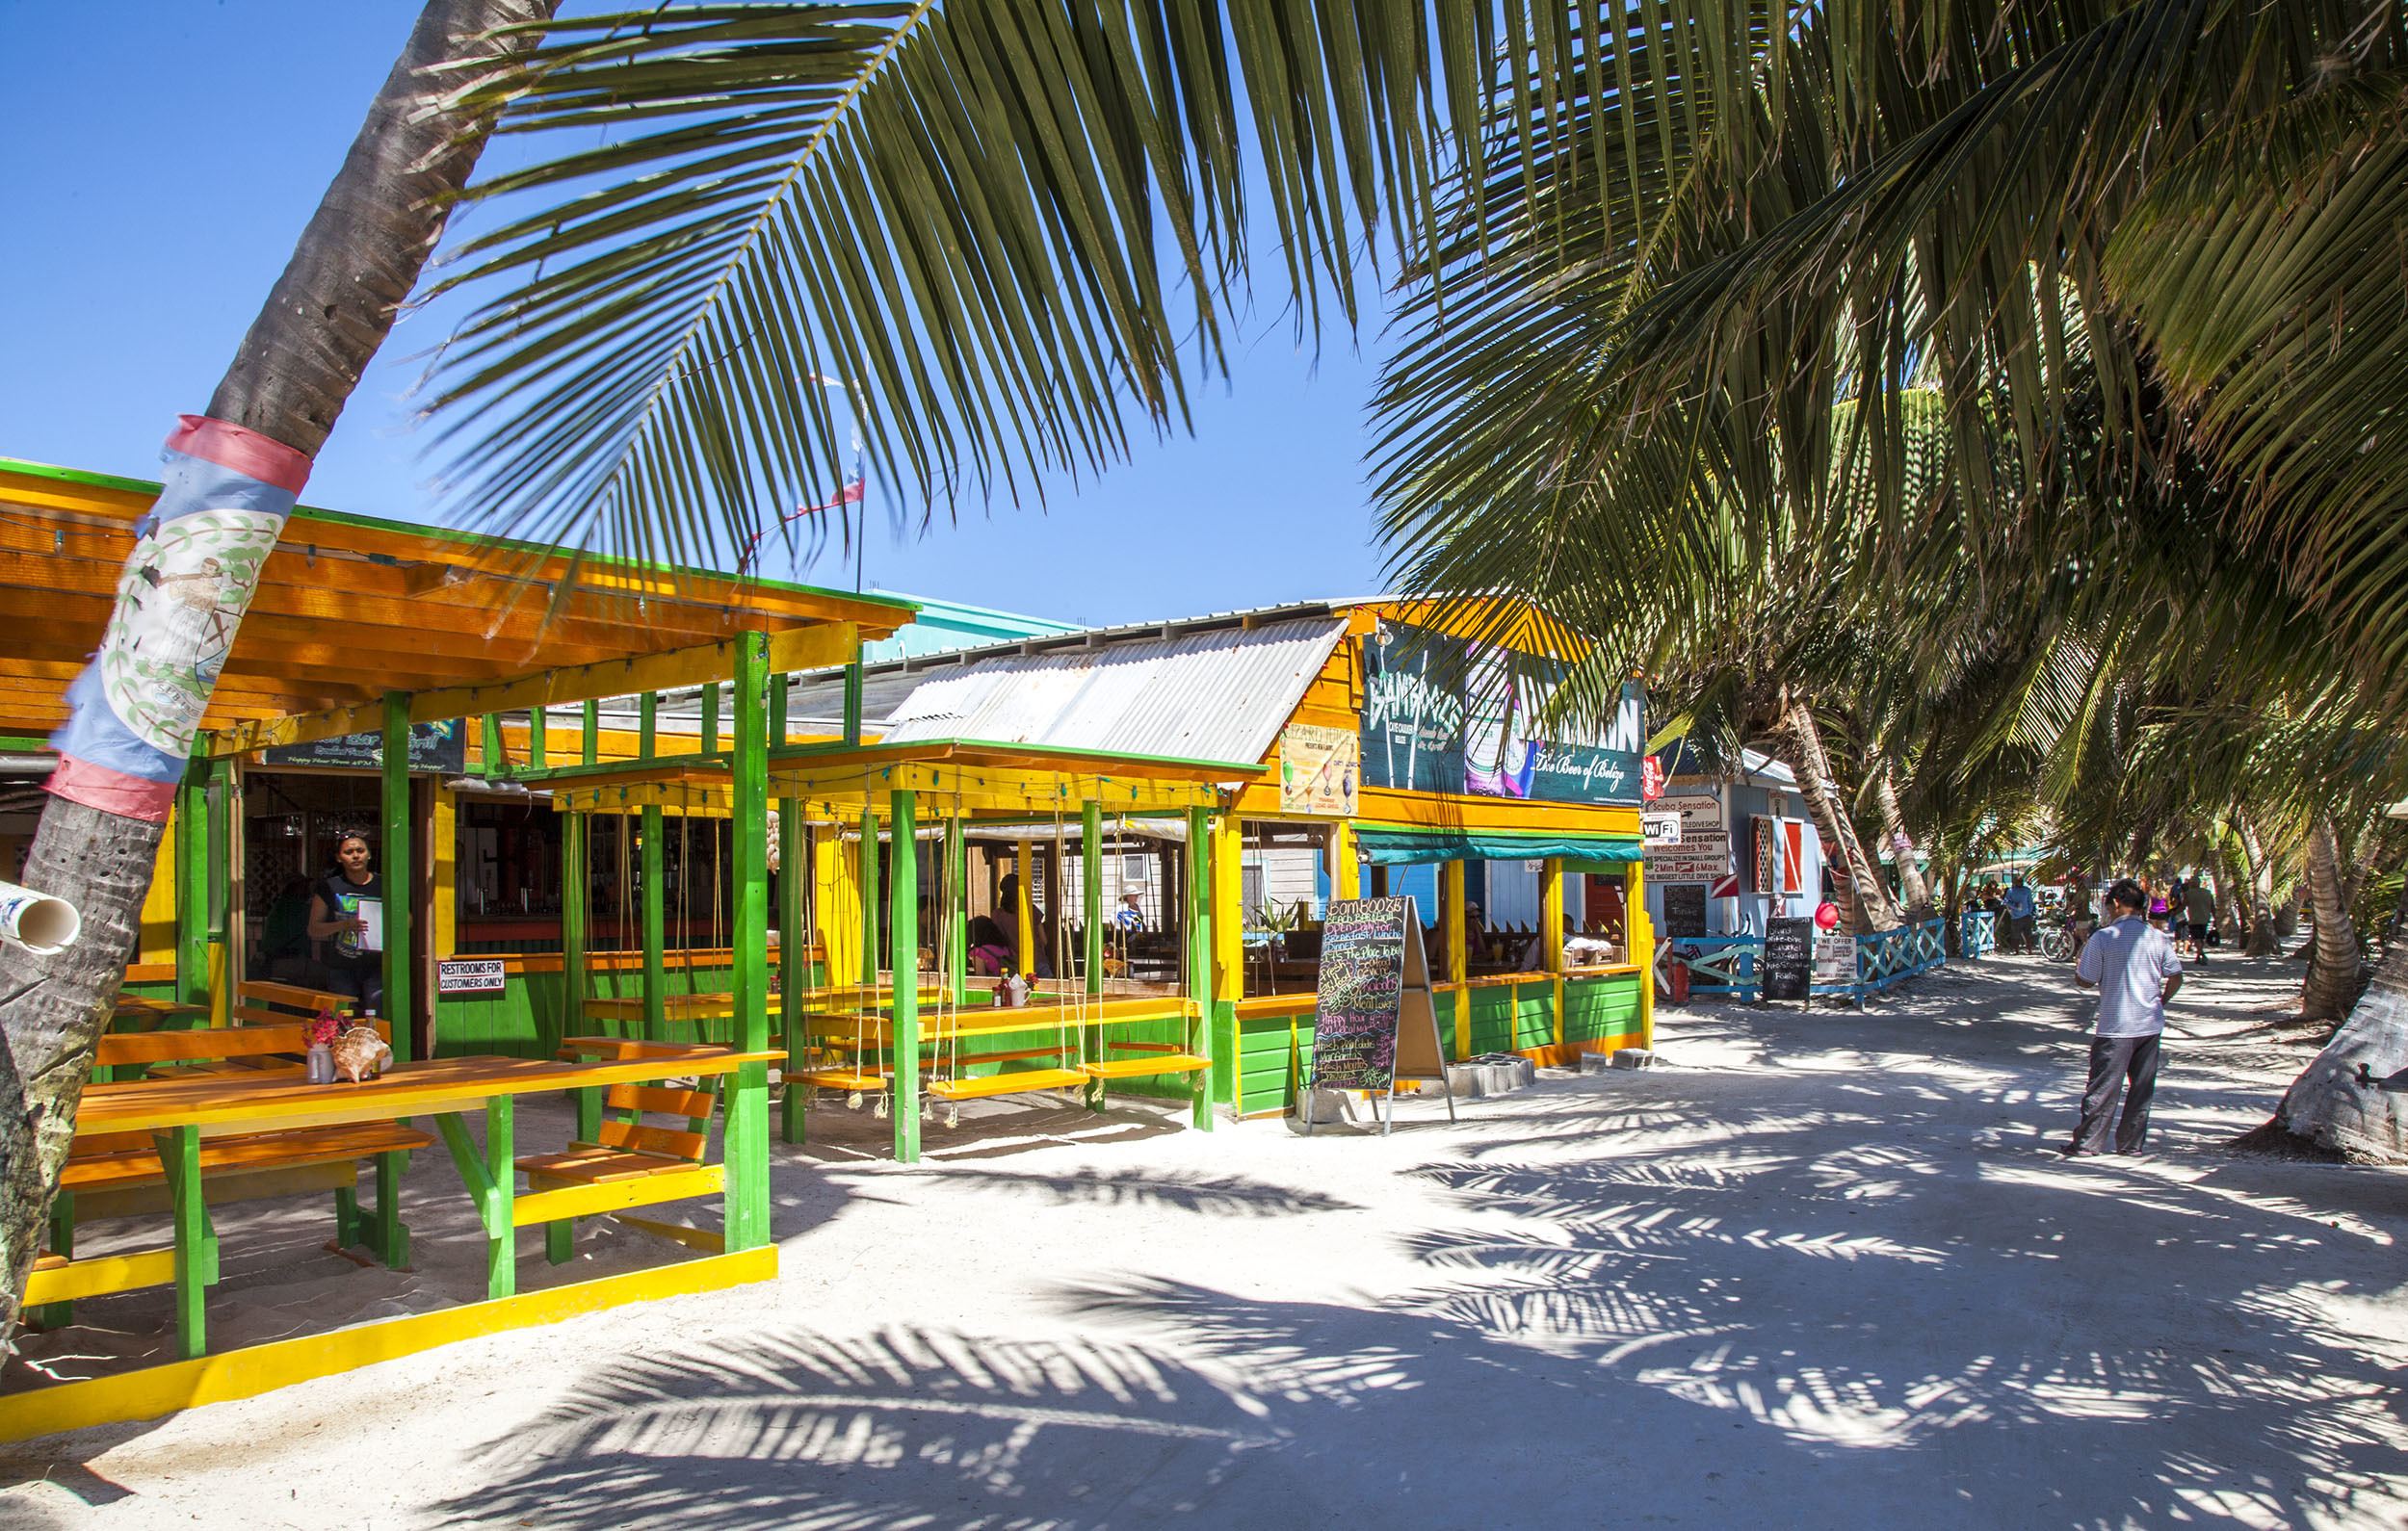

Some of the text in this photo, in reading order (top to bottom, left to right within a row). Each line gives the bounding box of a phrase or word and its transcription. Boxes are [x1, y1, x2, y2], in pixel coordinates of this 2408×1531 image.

[1557, 754, 1583, 777] Beer
[1584, 755, 1600, 790] of
[1594, 759, 1625, 792] Belize
[1653, 801, 1716, 811] Scuba Sensation
[1681, 834, 1726, 843] Sensation
[1654, 844, 1696, 853] Welcomes
[441, 962, 502, 974] RESTROOMS FOR
[441, 976, 503, 989] CUSTOMERS ONLY
